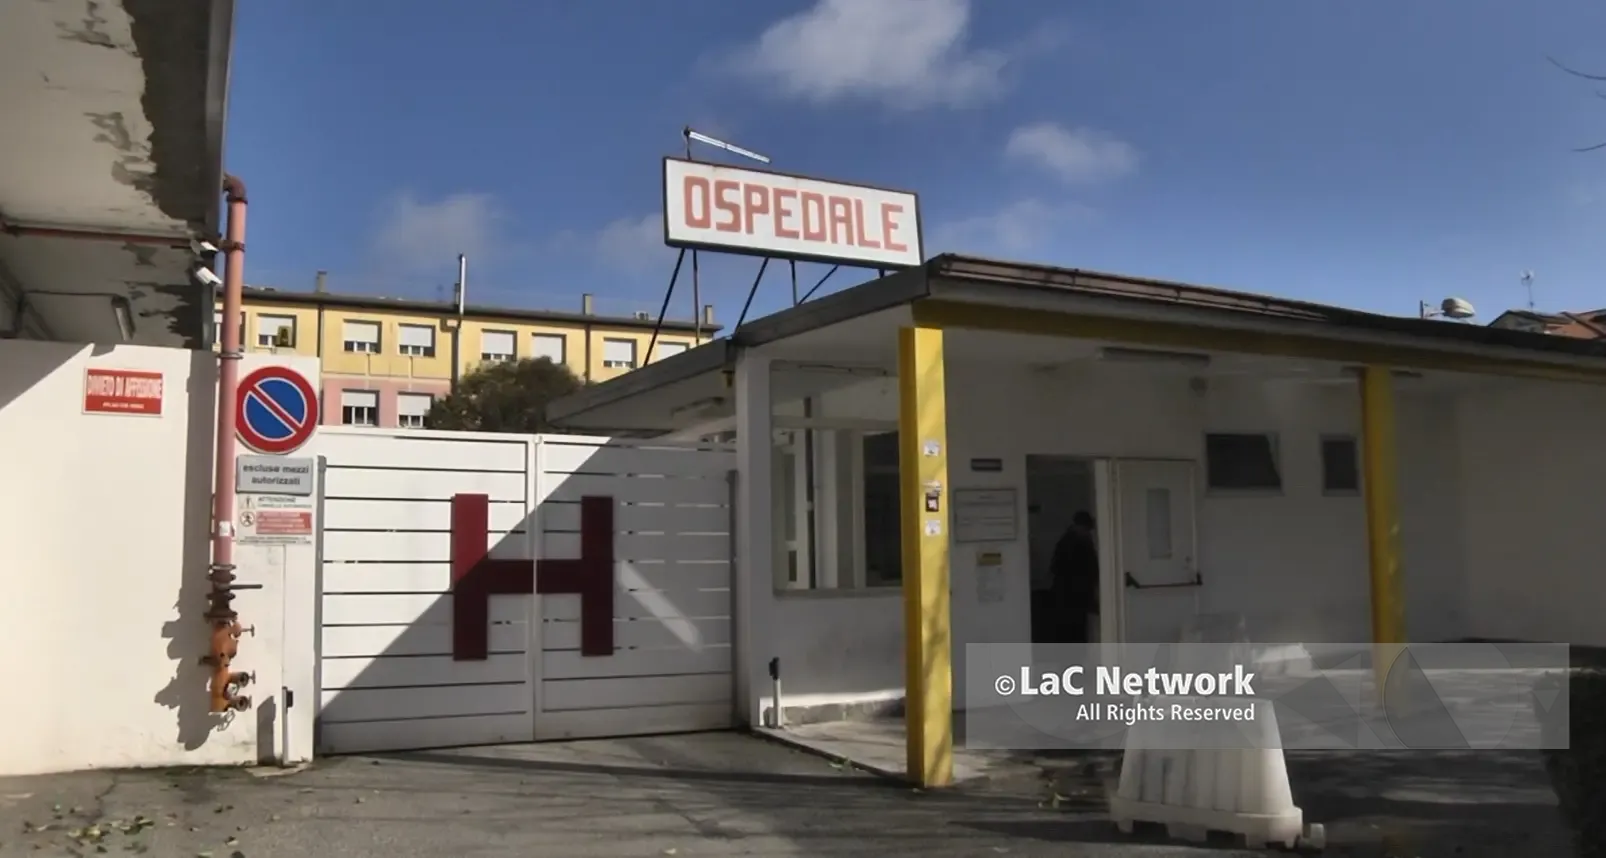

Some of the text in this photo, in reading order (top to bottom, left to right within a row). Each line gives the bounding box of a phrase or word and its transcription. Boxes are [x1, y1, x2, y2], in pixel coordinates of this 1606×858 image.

[684, 176, 907, 252] OSPEDALE
[282, 465, 309, 474] mezzi
[451, 494, 613, 661] H
